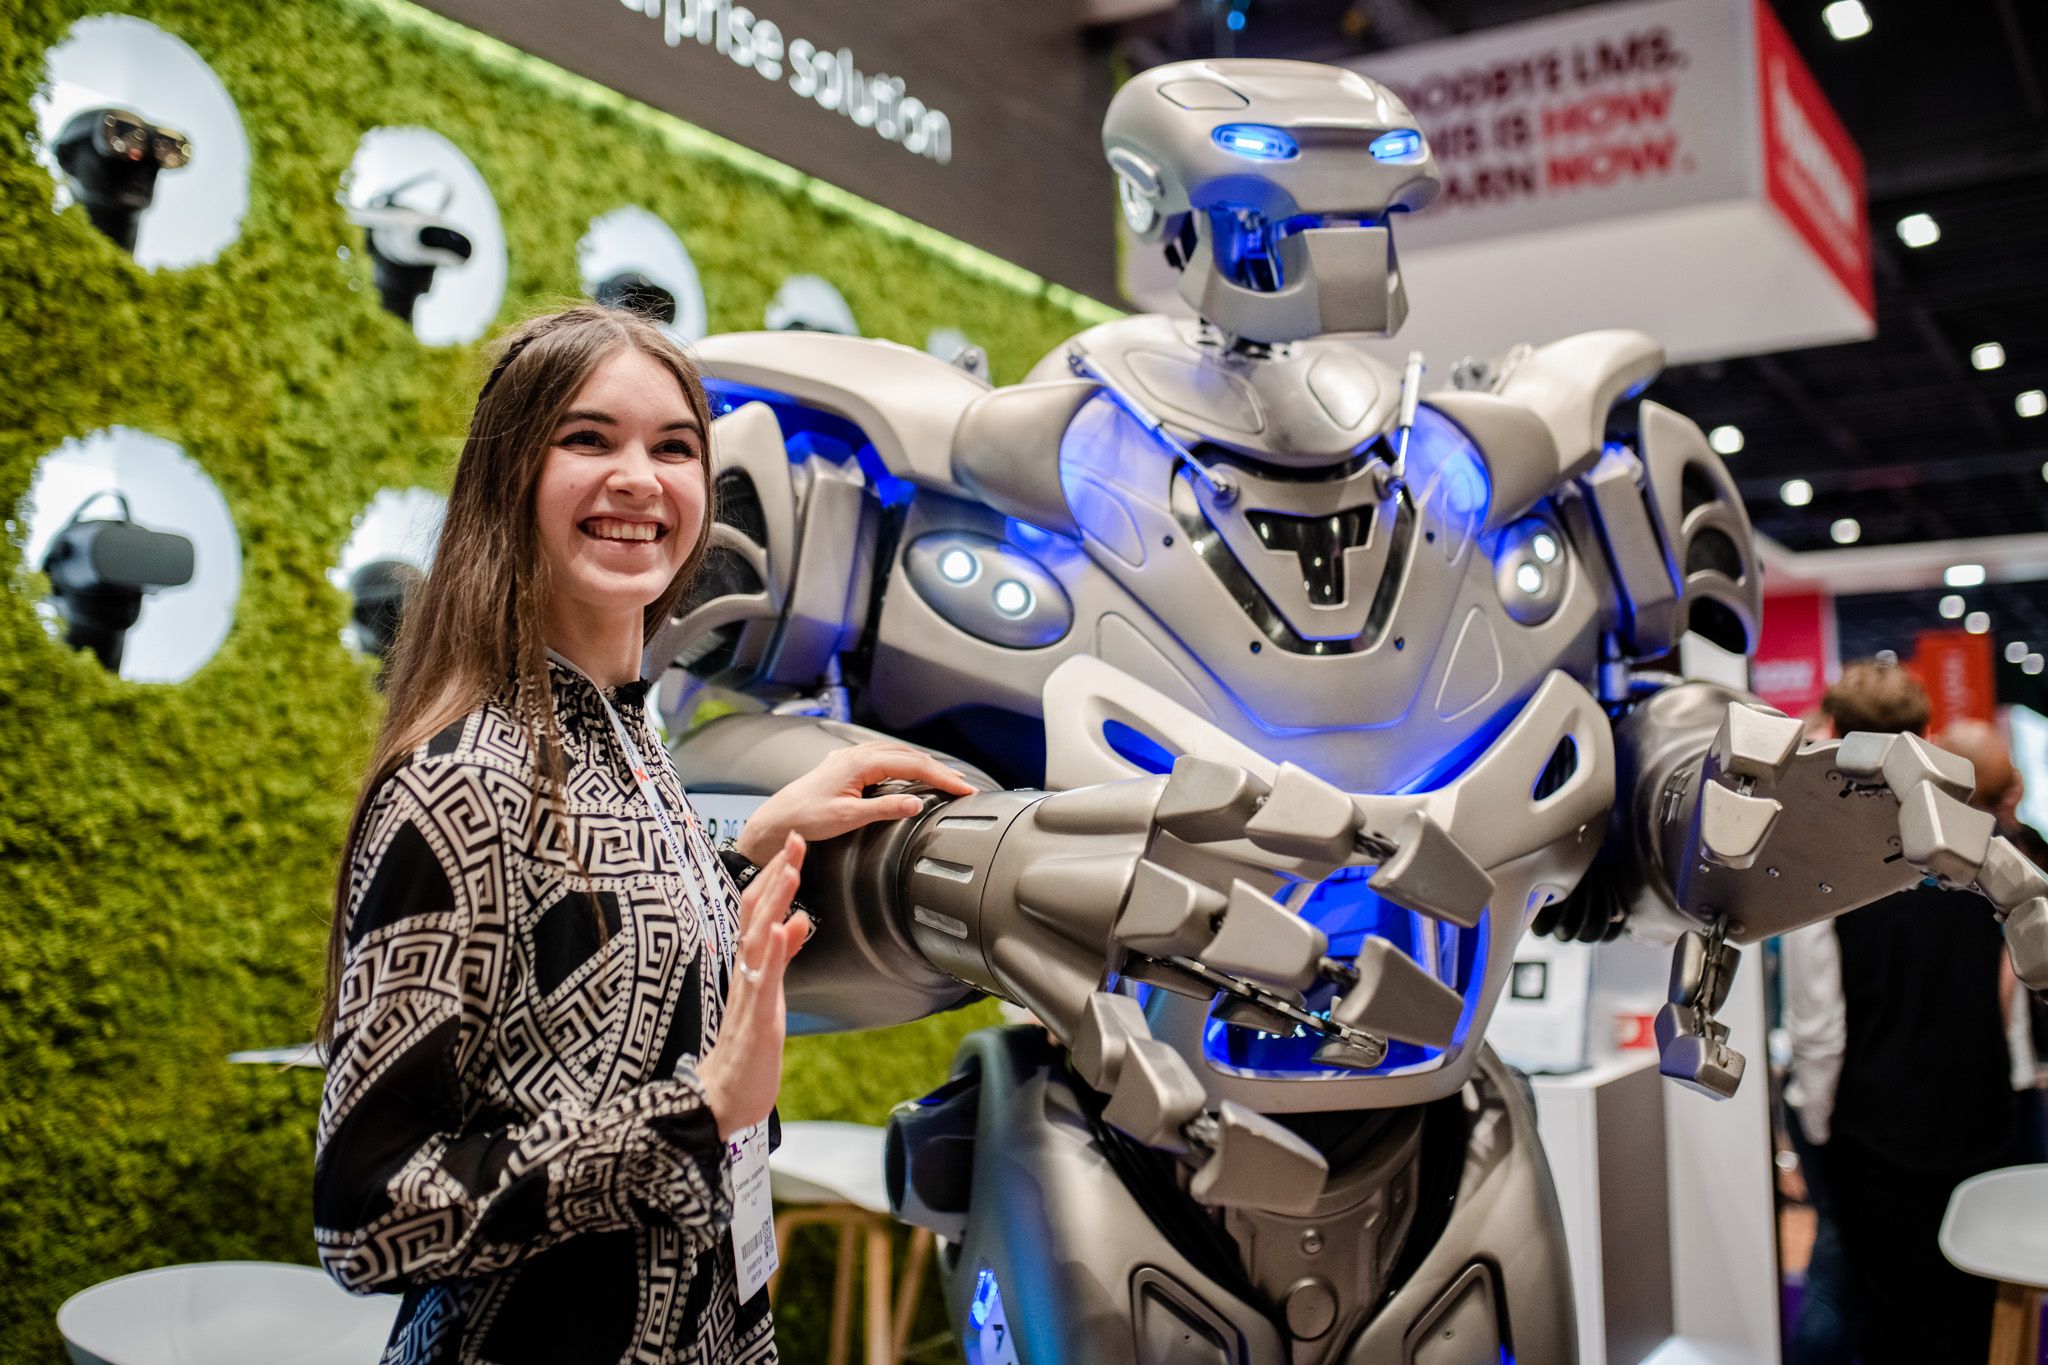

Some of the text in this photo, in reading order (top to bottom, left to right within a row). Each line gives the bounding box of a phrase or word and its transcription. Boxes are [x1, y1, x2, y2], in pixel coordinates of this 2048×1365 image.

[788, 38, 952, 165] solution
[1541, 82, 1676, 140] HOW
[652, 802, 686, 870] articulate
[713, 898, 732, 968] articulate
